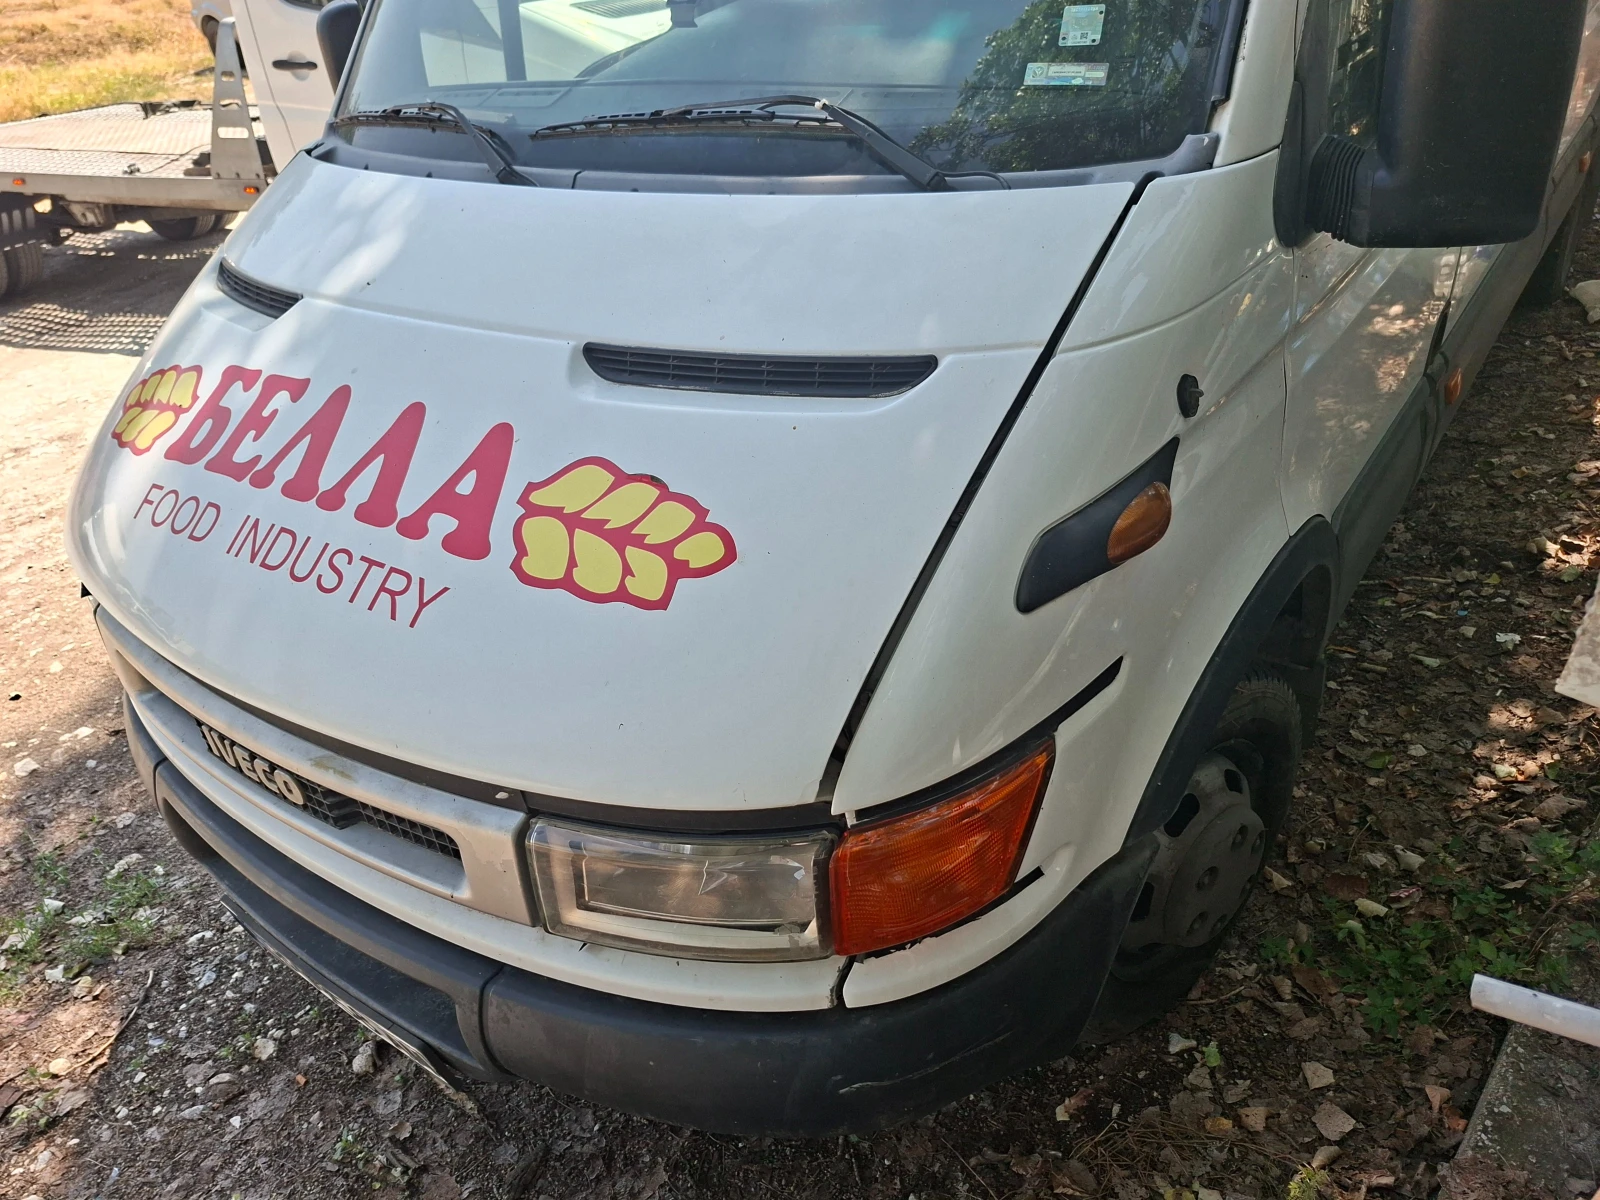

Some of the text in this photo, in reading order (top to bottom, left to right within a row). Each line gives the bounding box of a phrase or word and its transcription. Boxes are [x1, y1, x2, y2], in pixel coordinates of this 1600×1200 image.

[164, 365, 515, 560] БЕЛЛА
[134, 483, 451, 629] FOOD INDUSTRY
[201, 724, 305, 805] IVECO
